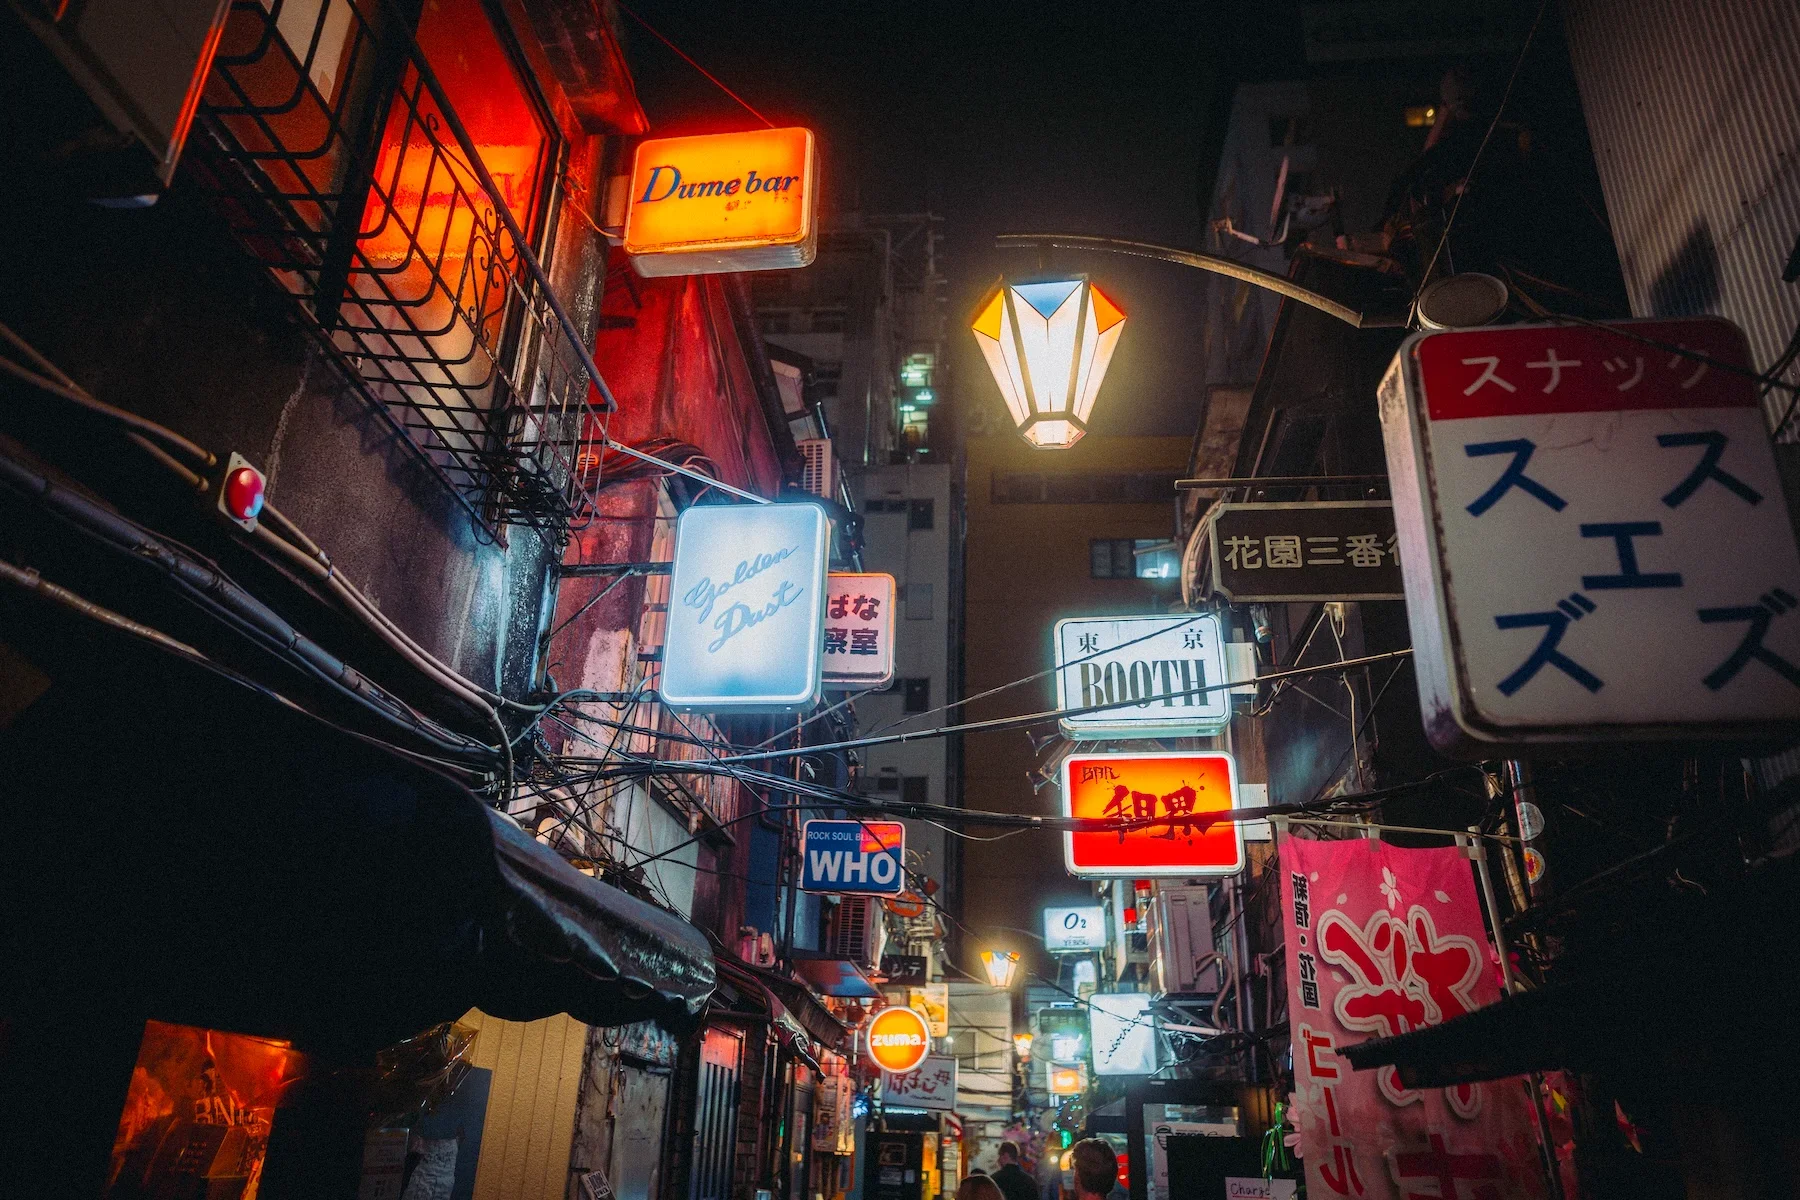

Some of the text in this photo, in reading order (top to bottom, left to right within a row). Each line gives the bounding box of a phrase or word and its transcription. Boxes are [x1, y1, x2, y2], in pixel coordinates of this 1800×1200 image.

[636, 165, 799, 204] Dume bar
[1461, 345, 1710, 396] スナック
[683, 545, 800, 624] Golden
[708, 580, 804, 654] Dust
[1080, 658, 1211, 709] BOOTH
[1080, 766, 1120, 784] BAR
[807, 831, 831, 841] ROCK
[832, 832, 853, 841] SOUL
[810, 850, 897, 885] WHO
